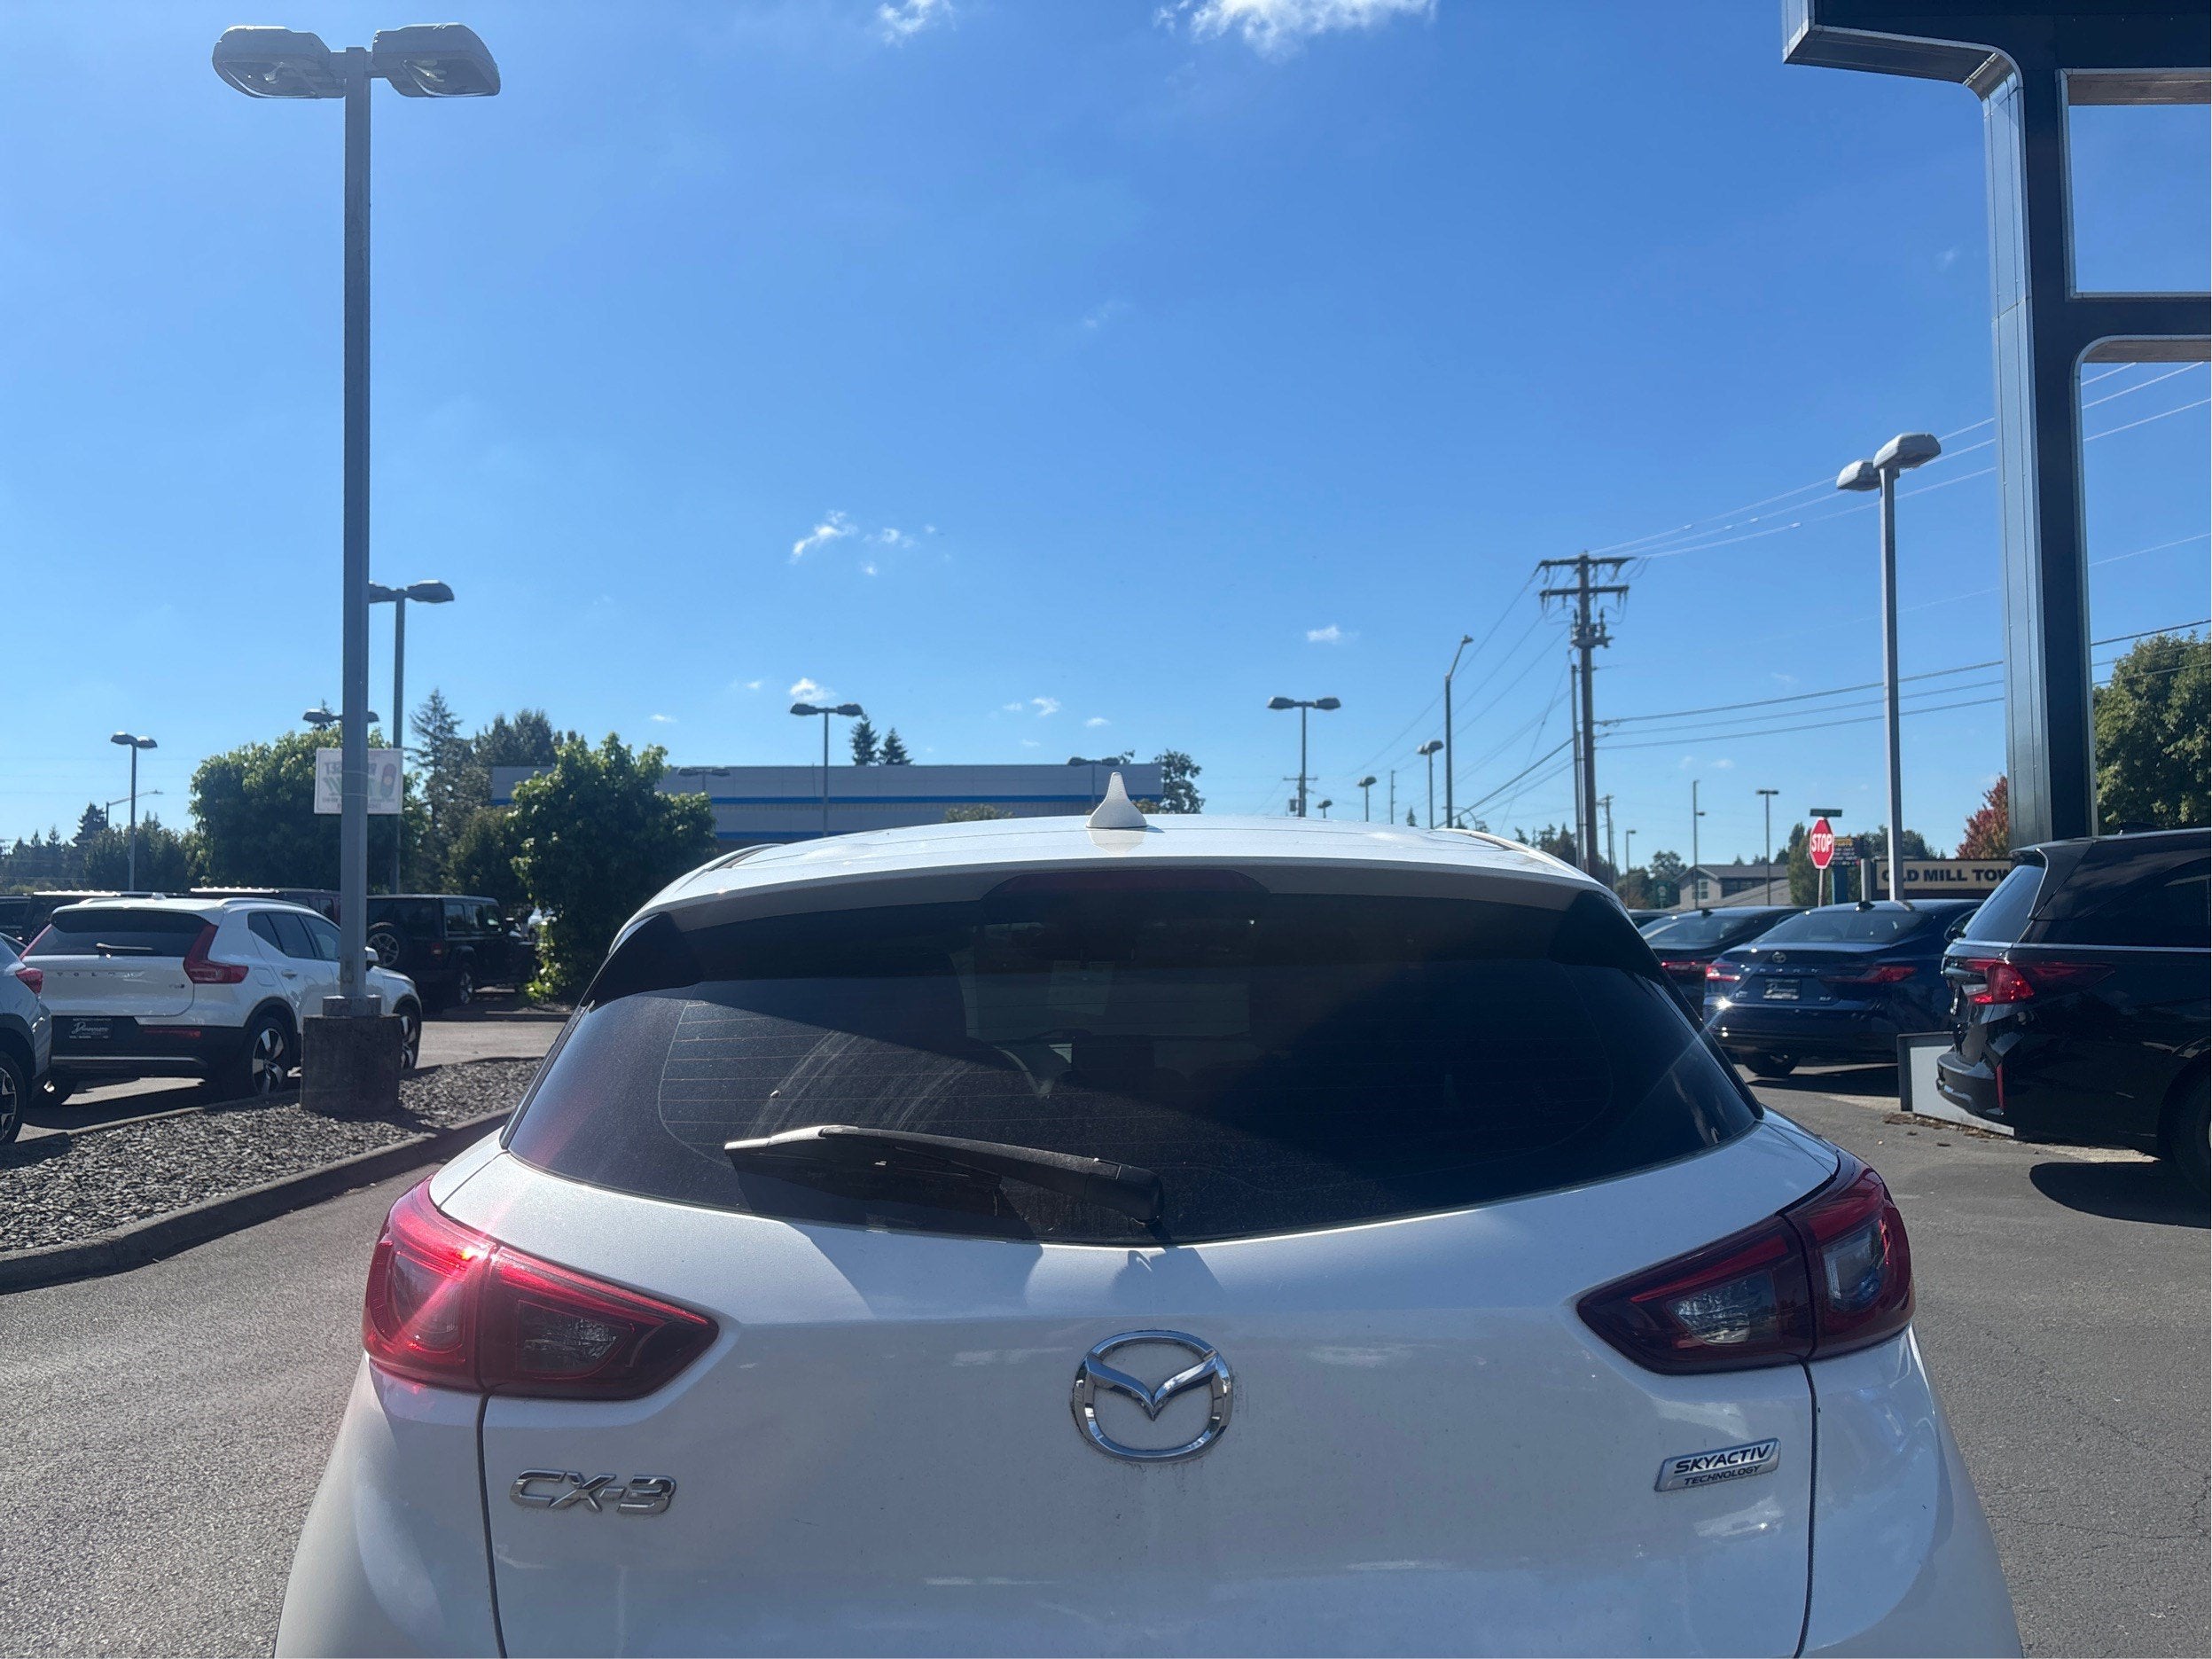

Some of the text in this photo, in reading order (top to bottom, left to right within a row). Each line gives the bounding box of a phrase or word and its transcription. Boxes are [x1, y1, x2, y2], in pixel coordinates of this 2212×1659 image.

[1811, 833, 1833, 853] STOP
[1881, 869, 1919, 881] OD
[1923, 868, 1968, 881] MILL
[1674, 1444, 1770, 1475] SKYACTIV
[1684, 1464, 1762, 1485] TECHNOLOGY
[509, 1467, 677, 1516] CX-3
